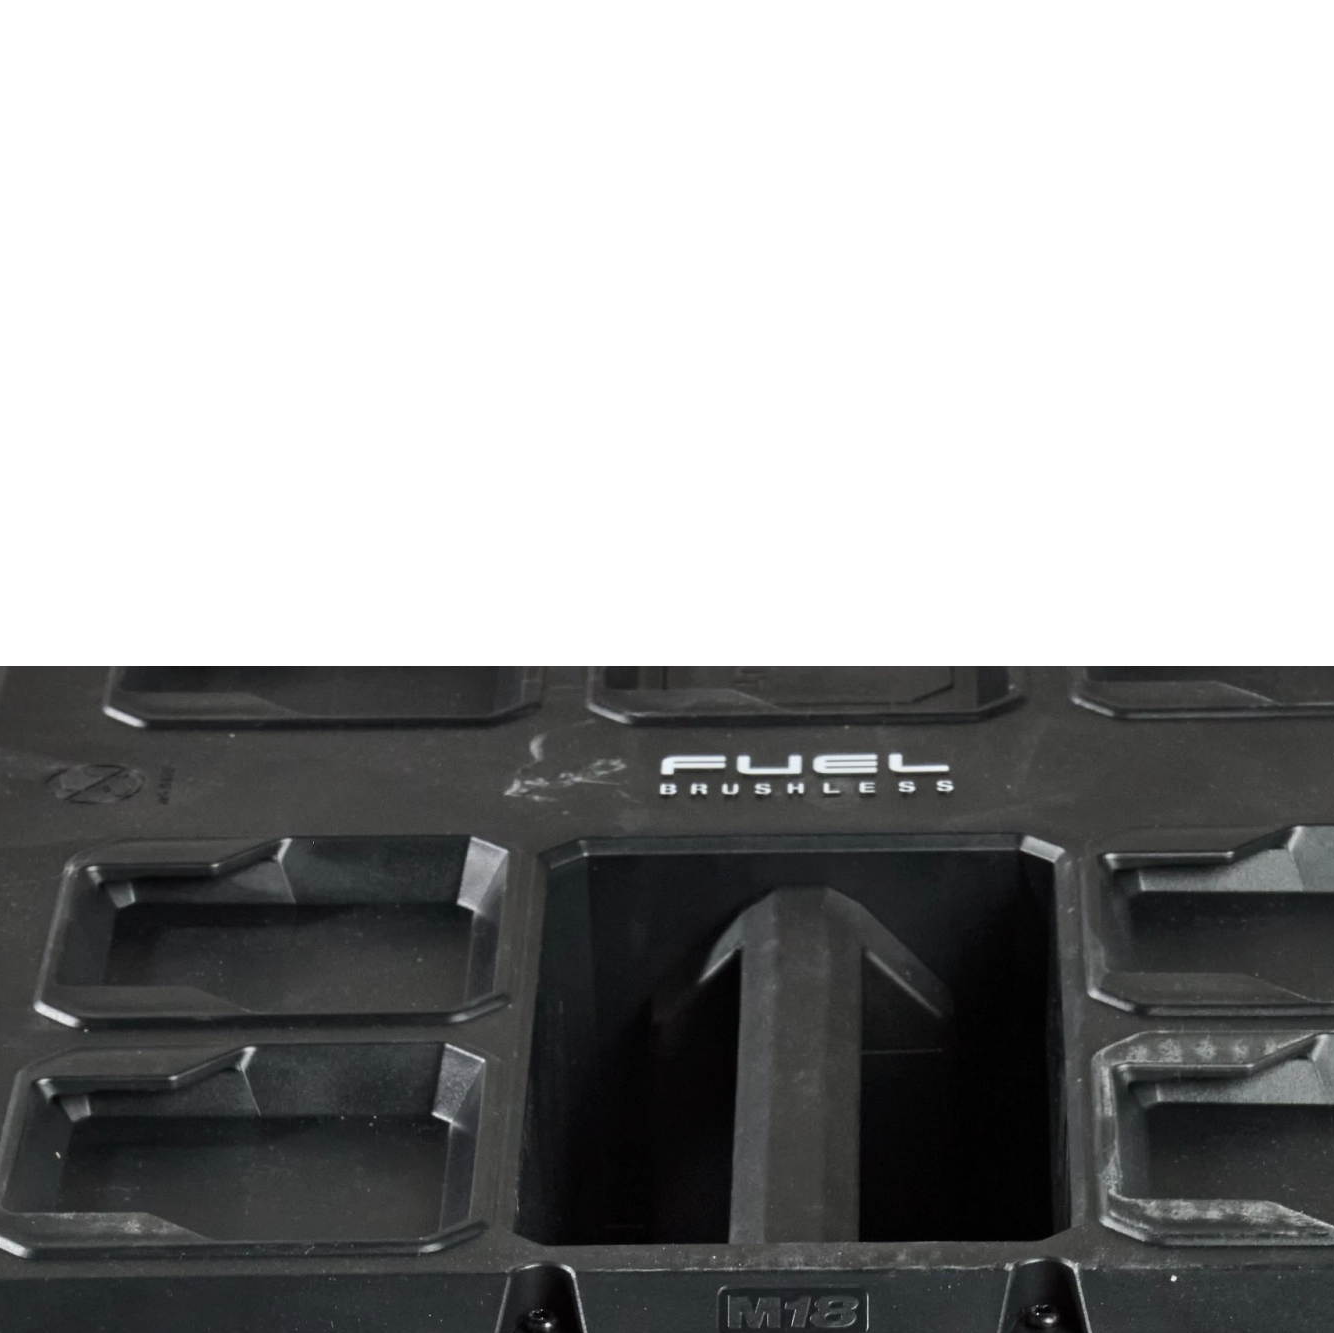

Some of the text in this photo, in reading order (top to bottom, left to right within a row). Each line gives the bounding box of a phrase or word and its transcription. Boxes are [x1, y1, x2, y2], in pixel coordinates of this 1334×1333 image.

[660, 753, 950, 775] FUEL
[659, 780, 954, 796] BRUSHLESS
[727, 1295, 859, 1329] M18
